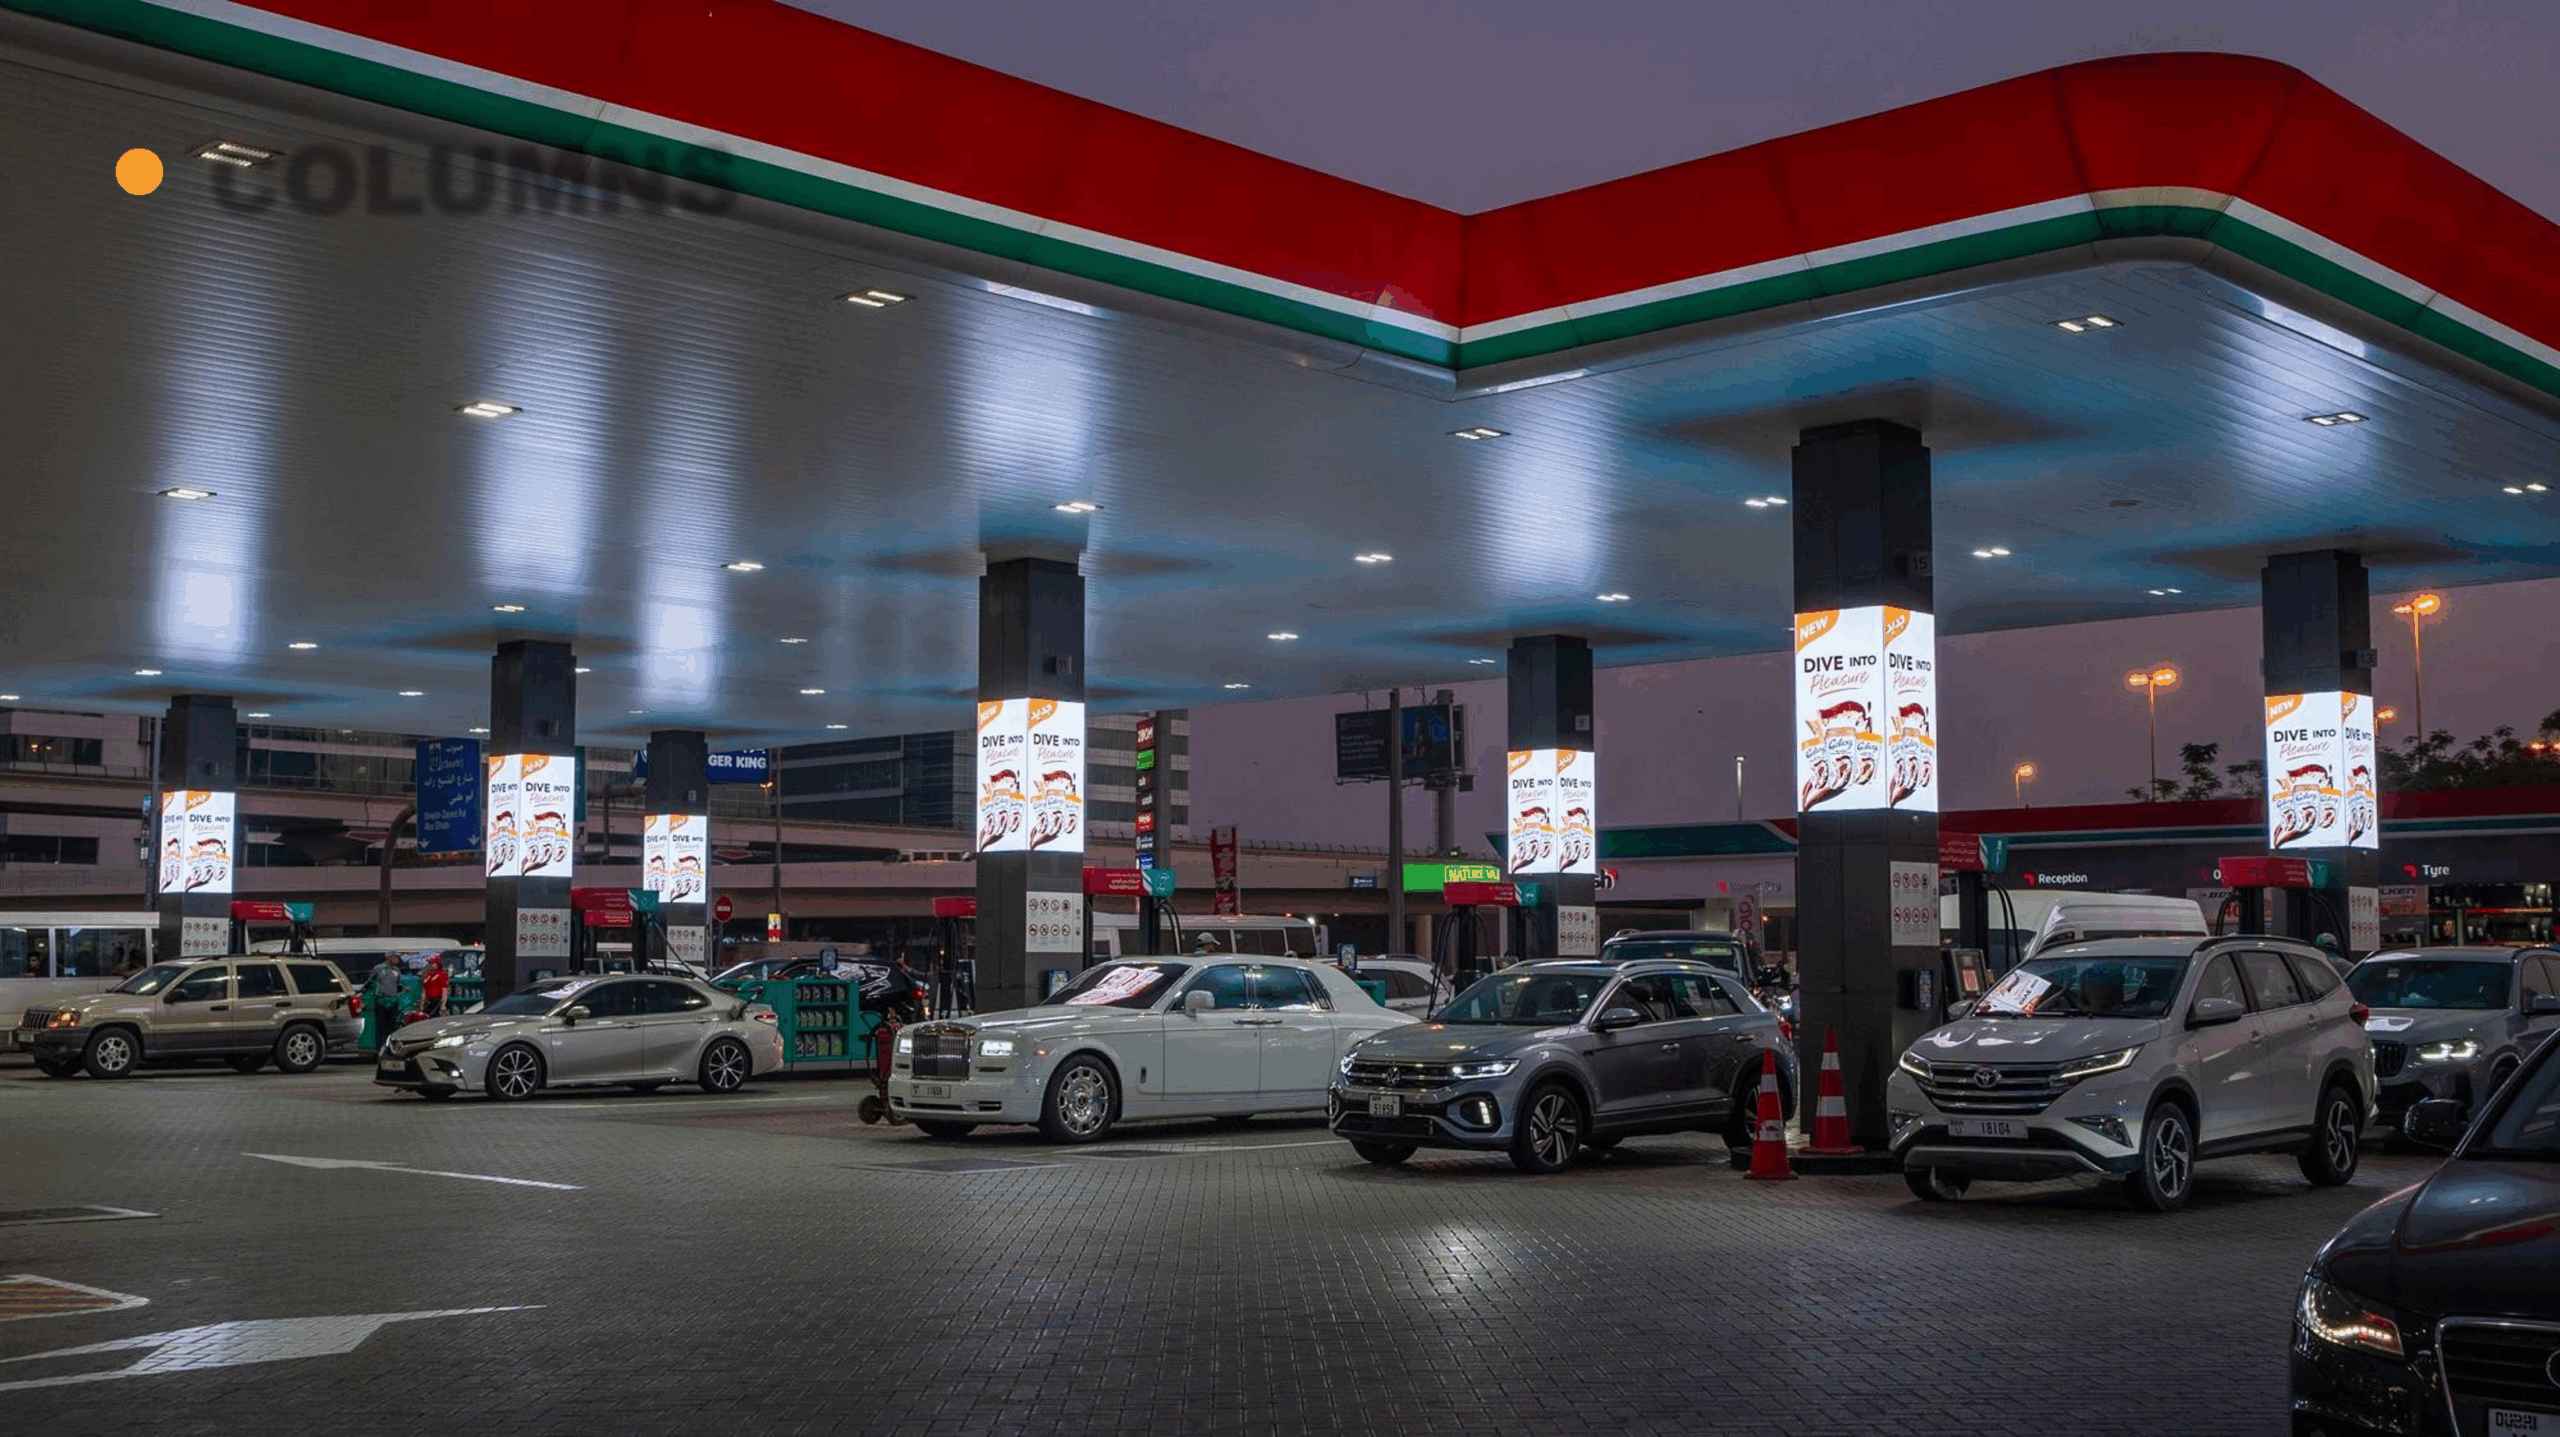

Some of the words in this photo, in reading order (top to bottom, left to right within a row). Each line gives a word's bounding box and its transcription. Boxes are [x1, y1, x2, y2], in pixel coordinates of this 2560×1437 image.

[1800, 615, 1828, 641] NEW
[1804, 655, 1843, 672] DIVE
[1849, 655, 1877, 667] INTO
[1889, 653, 1912, 671] DIVE
[1916, 660, 1931, 671] INTO
[1810, 670, 1871, 693] Pleasure
[2269, 698, 2294, 719] NEW
[982, 735, 1005, 748] DIVE
[1008, 735, 1024, 744] INTO
[1033, 734, 1059, 746] DIVE
[1062, 738, 1080, 746] INTO
[2274, 729, 2308, 742] DIVE
[2313, 729, 2336, 738] INTO
[708, 755, 733, 768] GER
[736, 756, 767, 769] KING
[491, 783, 506, 793] DIVE
[525, 782, 550, 793] DIVE
[1512, 778, 1535, 789] DIVE
[1560, 777, 1578, 788] DIVE
[189, 814, 212, 823] DIVE
[2422, 864, 2450, 878] Tyre
[2038, 872, 2088, 885] Reception
[1981, 1121, 2010, 1135] 18104
[2495, 1411, 2537, 1431] DUBAI
